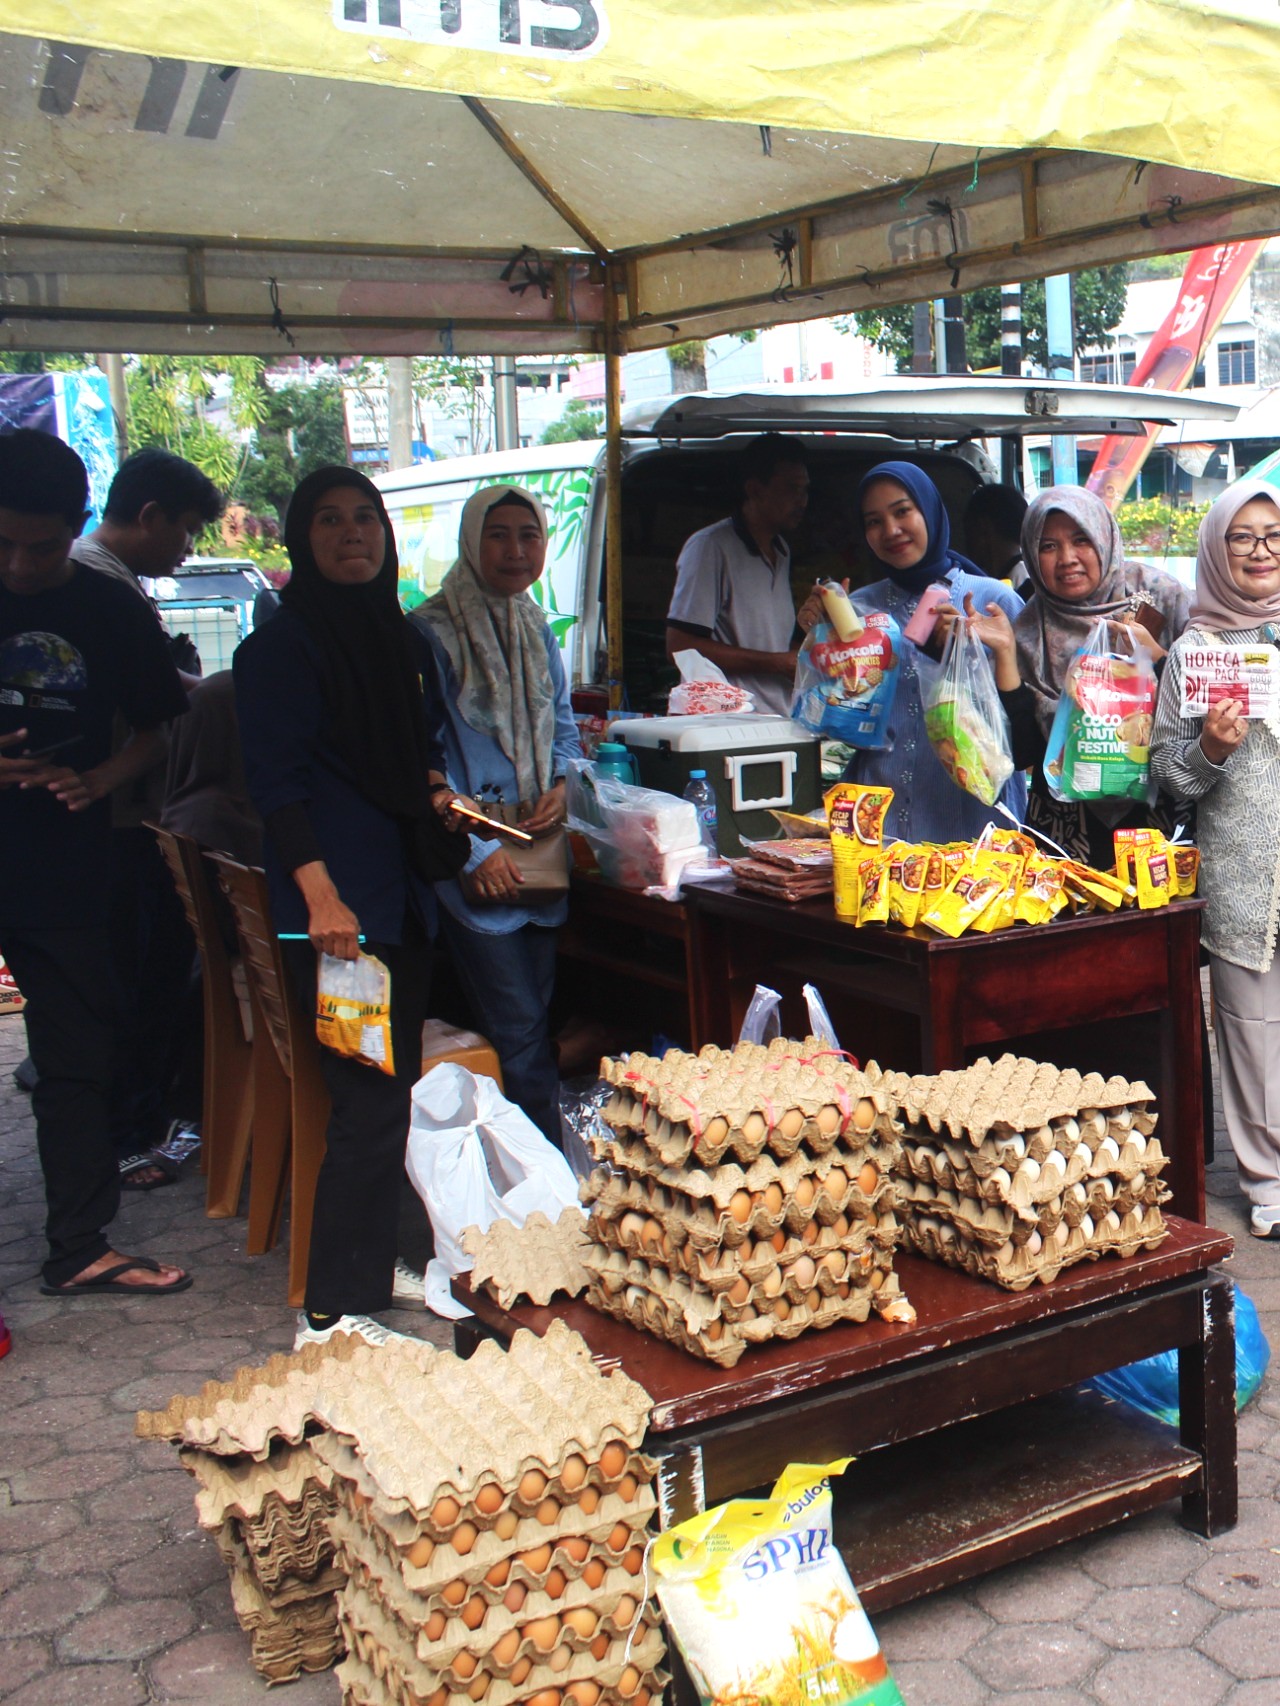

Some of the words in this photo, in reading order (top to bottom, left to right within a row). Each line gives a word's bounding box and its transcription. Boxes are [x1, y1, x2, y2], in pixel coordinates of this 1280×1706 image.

[829, 644, 884, 665] Kokola
[1185, 652, 1240, 668] HORECA
[1215, 668, 1240, 681] PACK
[1082, 713, 1122, 727] COCO
[1086, 727, 1117, 740] NUT
[1077, 741, 1130, 754] FESTIVE
[806, 1673, 821, 1701] 5
